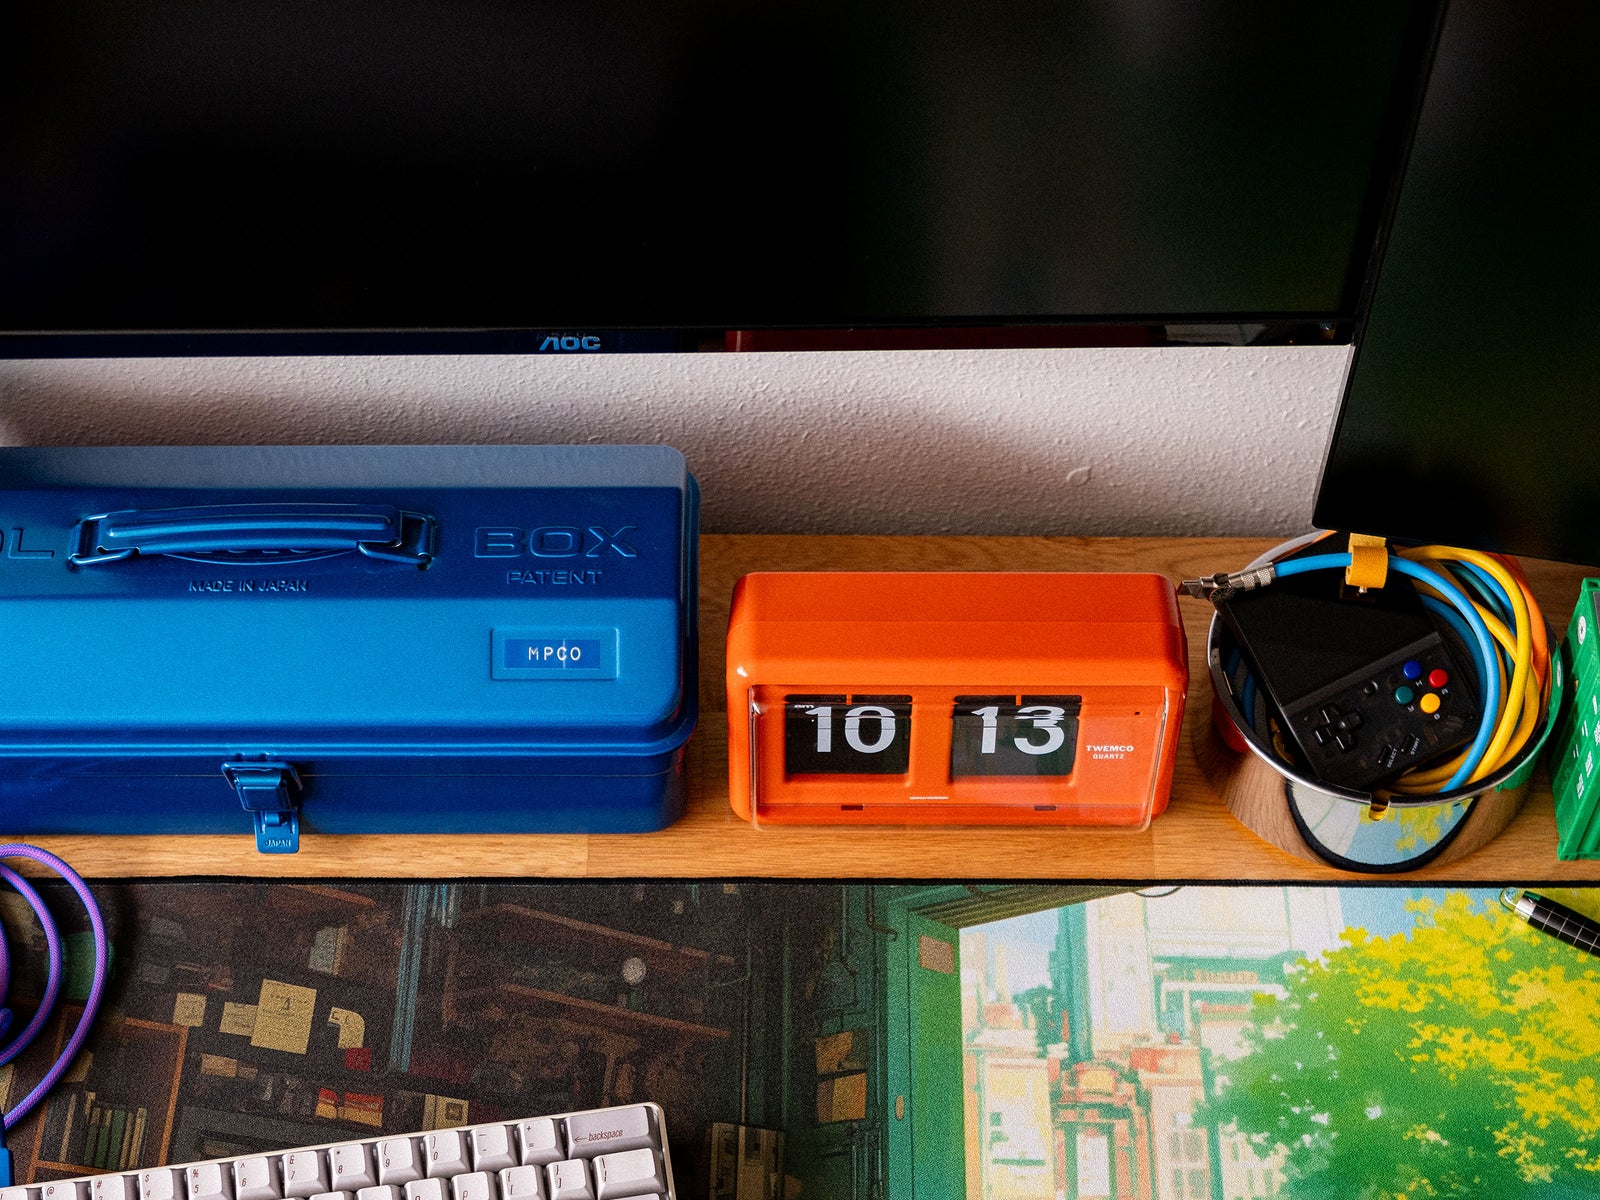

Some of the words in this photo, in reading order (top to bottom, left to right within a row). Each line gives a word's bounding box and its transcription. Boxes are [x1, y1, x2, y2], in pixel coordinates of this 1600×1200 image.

[539, 336, 600, 351] AOC
[474, 526, 637, 558] BOX
[507, 570, 602, 584] PATENT
[189, 580, 234, 592] MADE
[239, 580, 254, 592] IN
[258, 580, 309, 592] JAPAN
[528, 646, 581, 661] MPCO
[805, 706, 896, 754] 10
[971, 705, 1065, 755] 13
[1387, 748, 1397, 768] SELECT
[265, 839, 291, 847] JAPAN
[588, 1129, 624, 1142] backspace
[433, 1151, 439, 1161] 0
[337, 1164, 343, 1174] 8
[384, 1158, 391, 1168] 9
[290, 1170, 296, 1180] 7
[241, 1177, 247, 1187] 6
[145, 1189, 151, 1198] 4
[193, 1184, 199, 1194] 5
